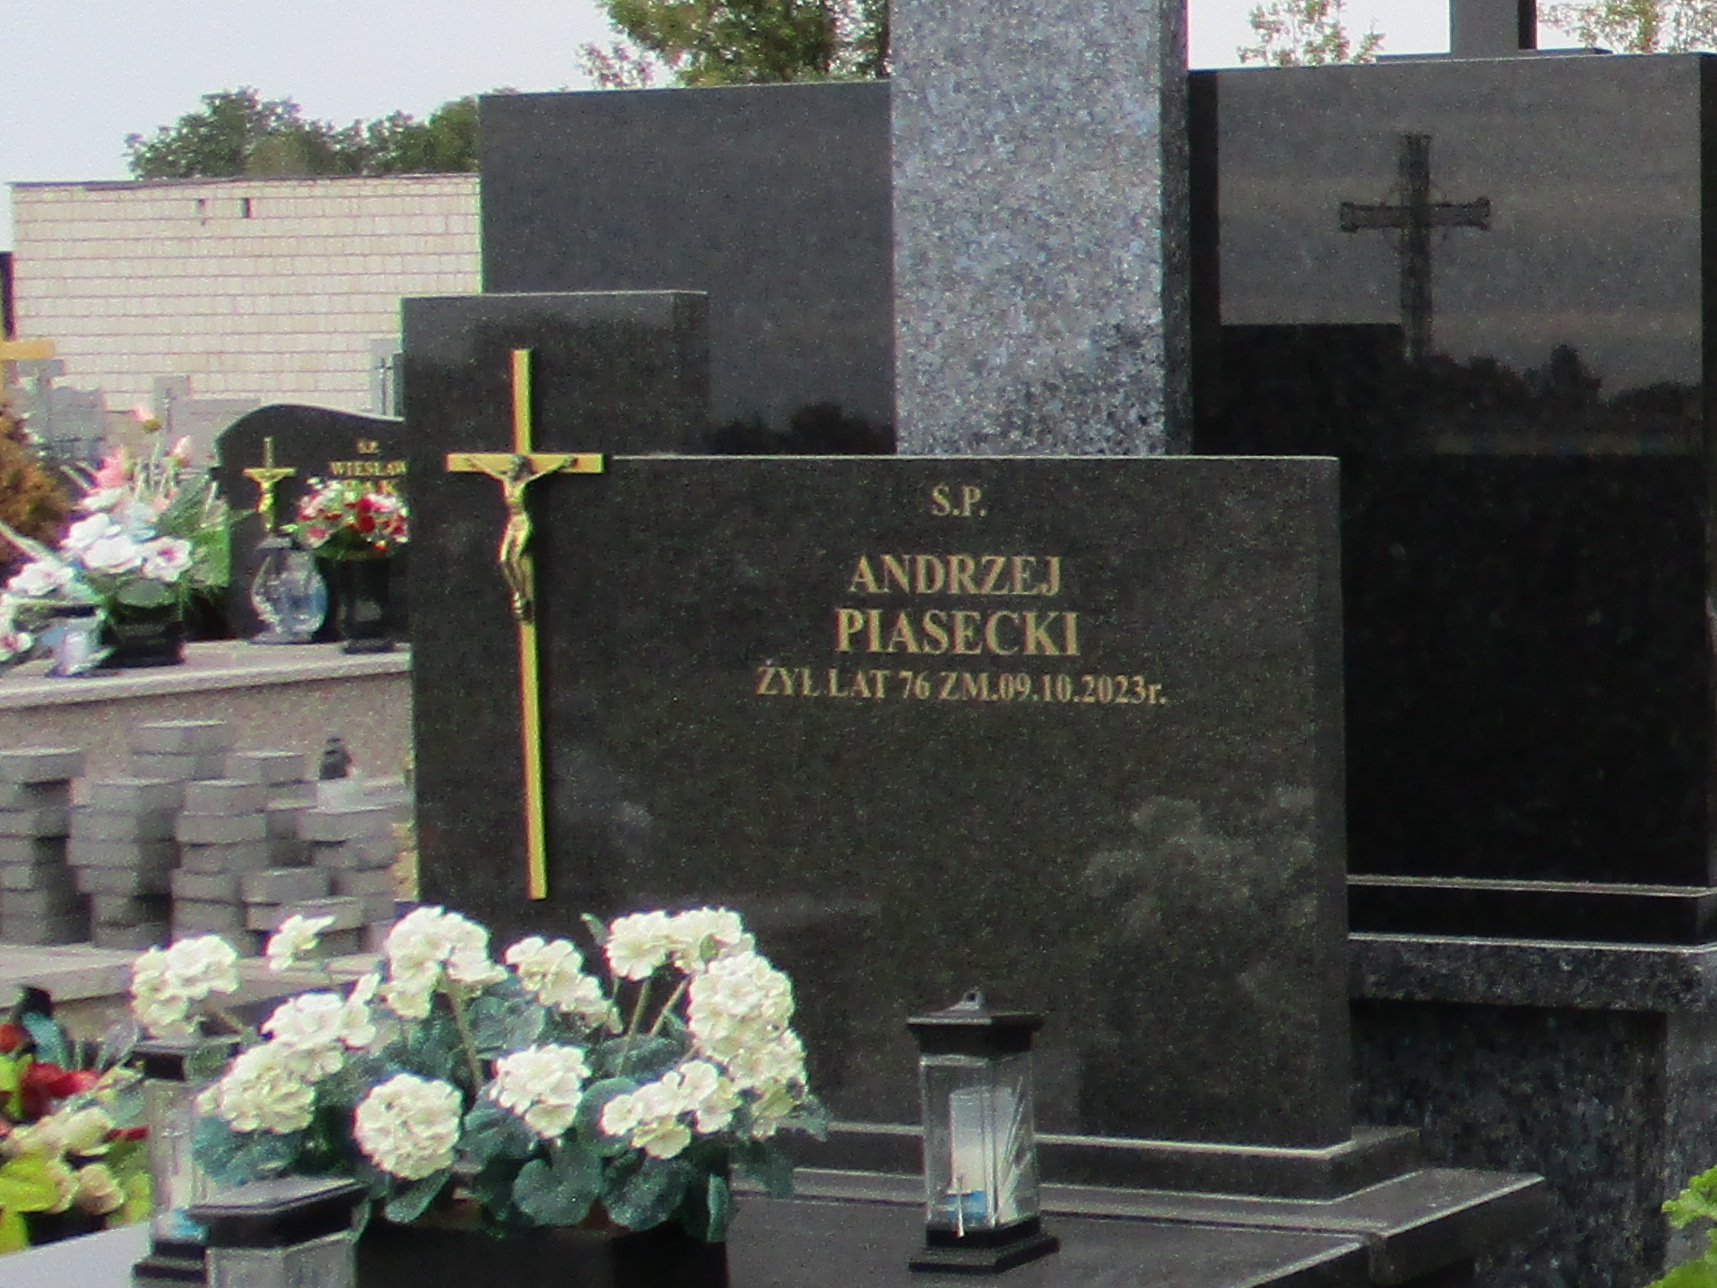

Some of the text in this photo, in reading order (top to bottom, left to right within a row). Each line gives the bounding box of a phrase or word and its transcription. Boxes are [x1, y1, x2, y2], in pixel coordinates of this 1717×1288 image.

[850, 554, 1062, 596] ANDRZEJ
[834, 608, 1081, 656] PIASECKI
[828, 668, 892, 699] LAT
[898, 670, 931, 700] 76
